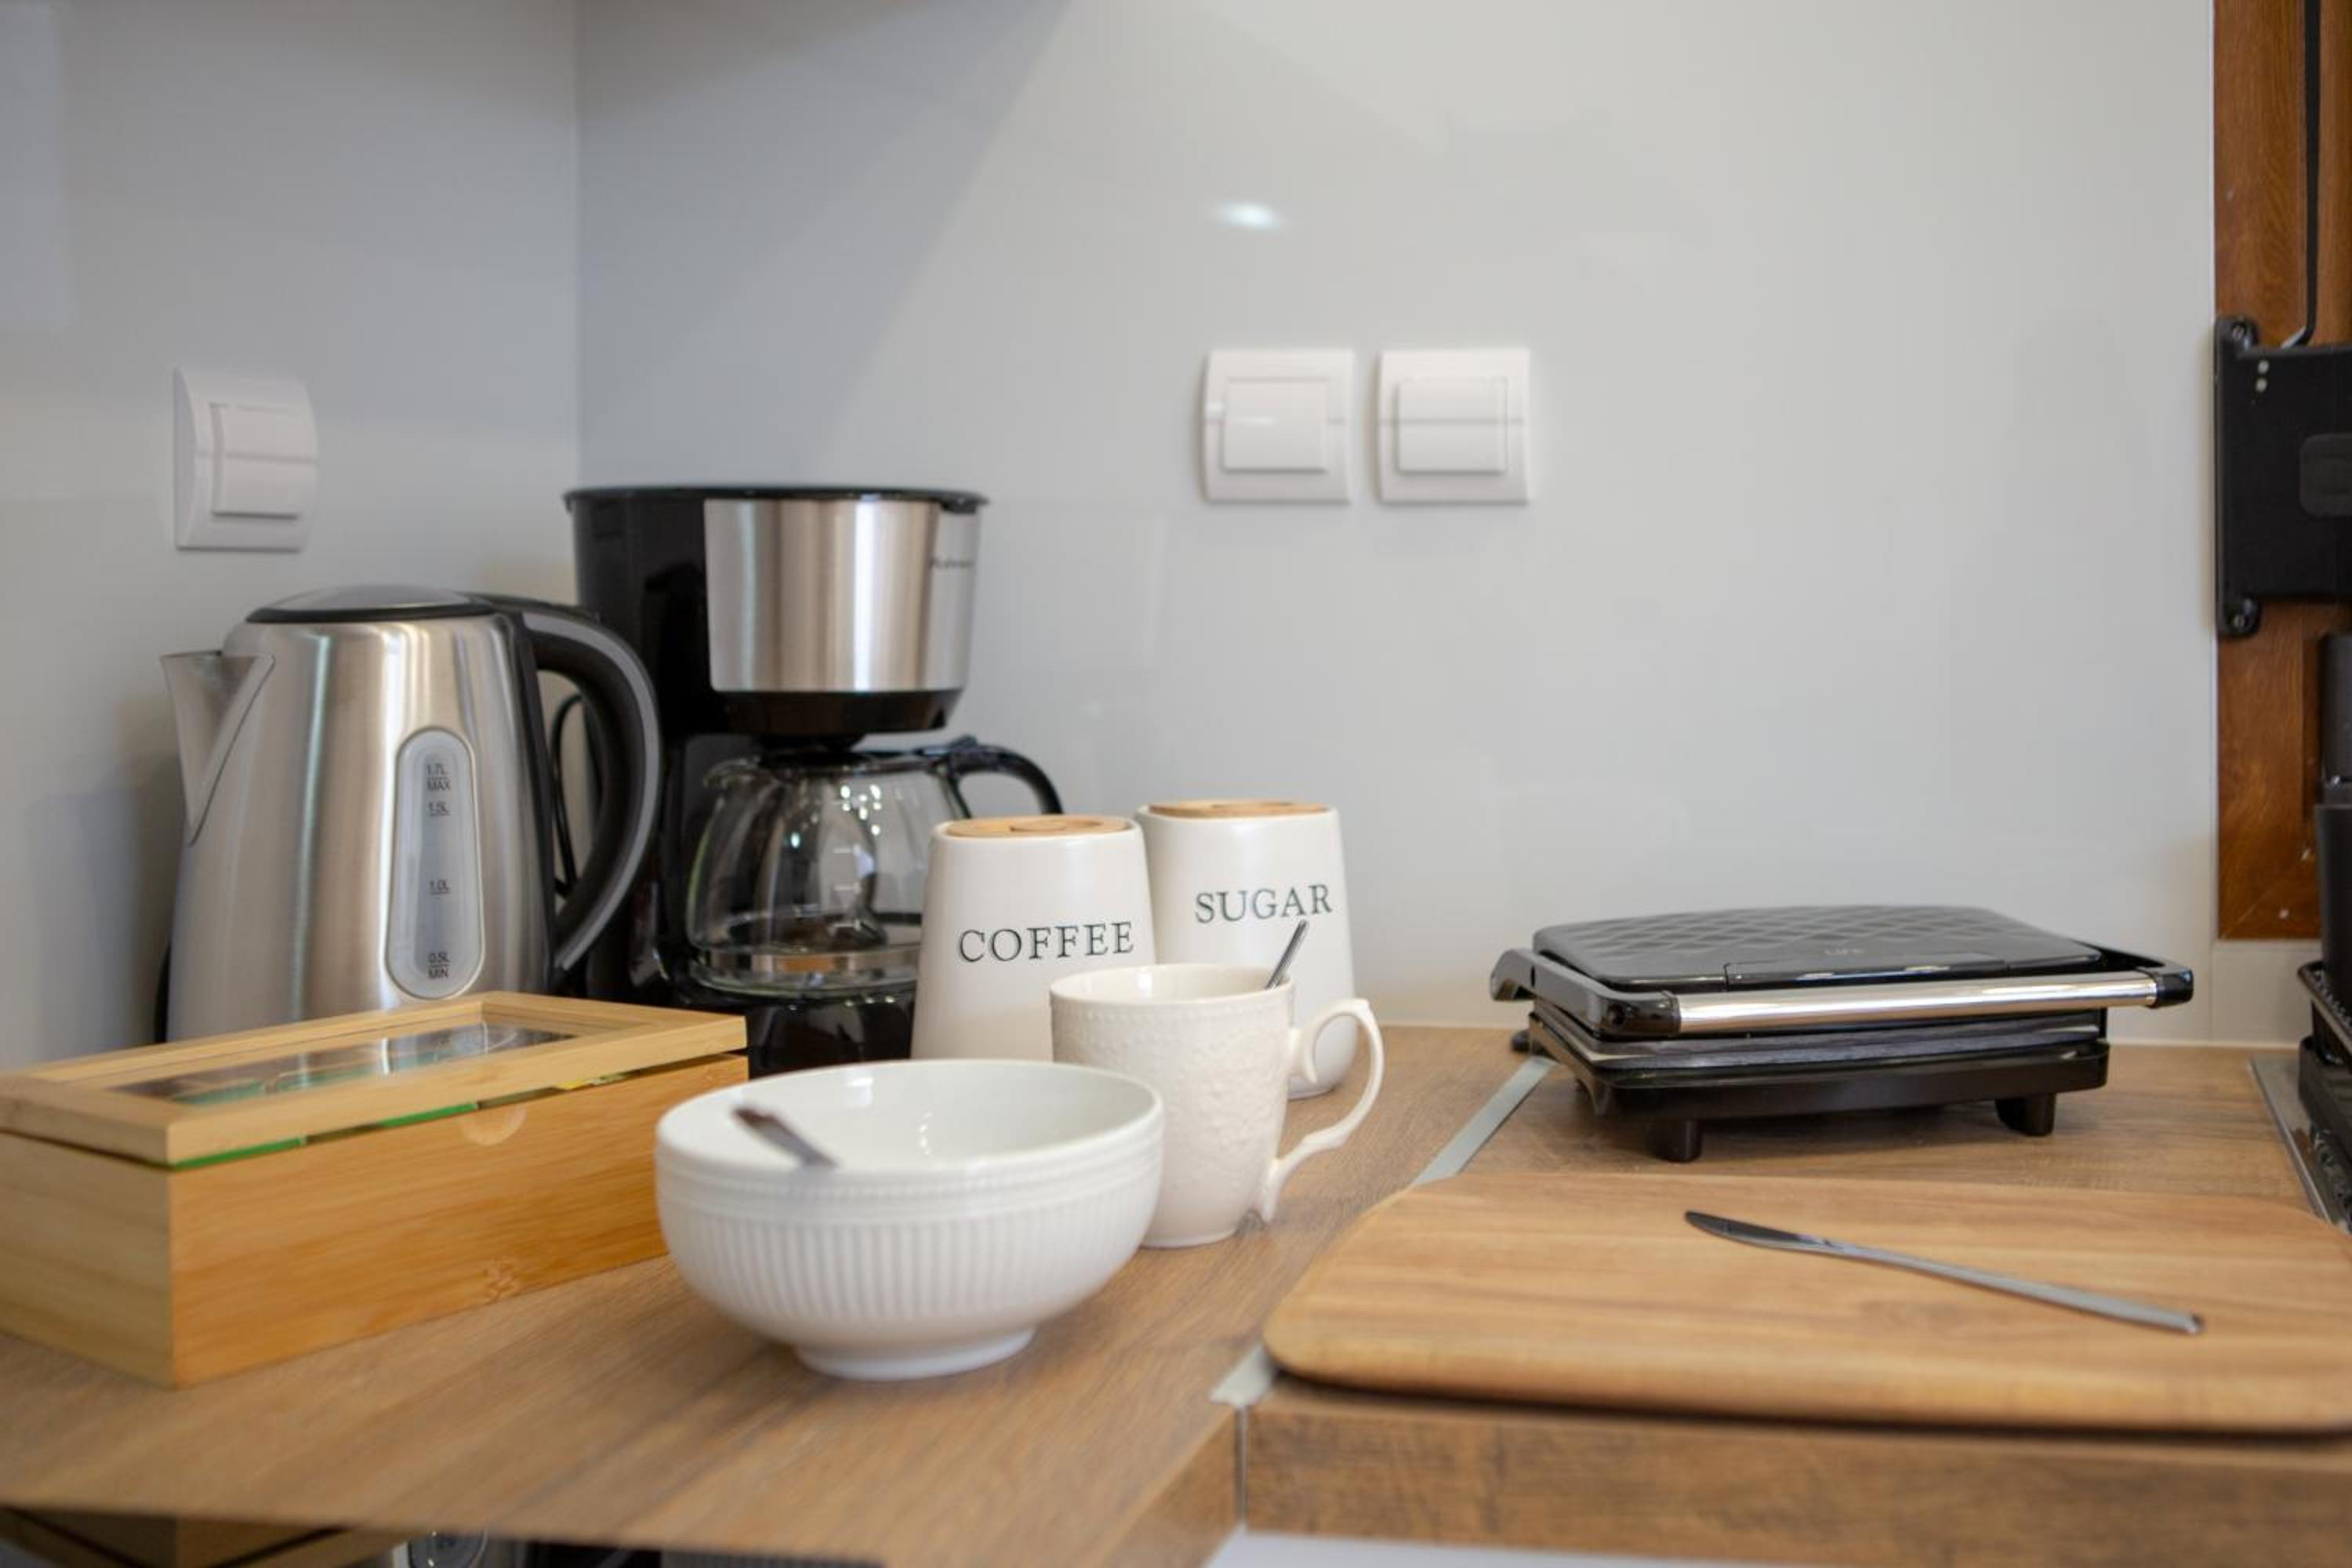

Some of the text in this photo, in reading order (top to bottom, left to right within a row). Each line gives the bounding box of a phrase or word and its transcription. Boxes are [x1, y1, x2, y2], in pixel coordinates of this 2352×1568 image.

[426, 779, 452, 791] MAX
[1194, 884, 1333, 924] SUGAR
[958, 921, 1134, 963] COFFEE
[428, 967, 448, 979] MIN
